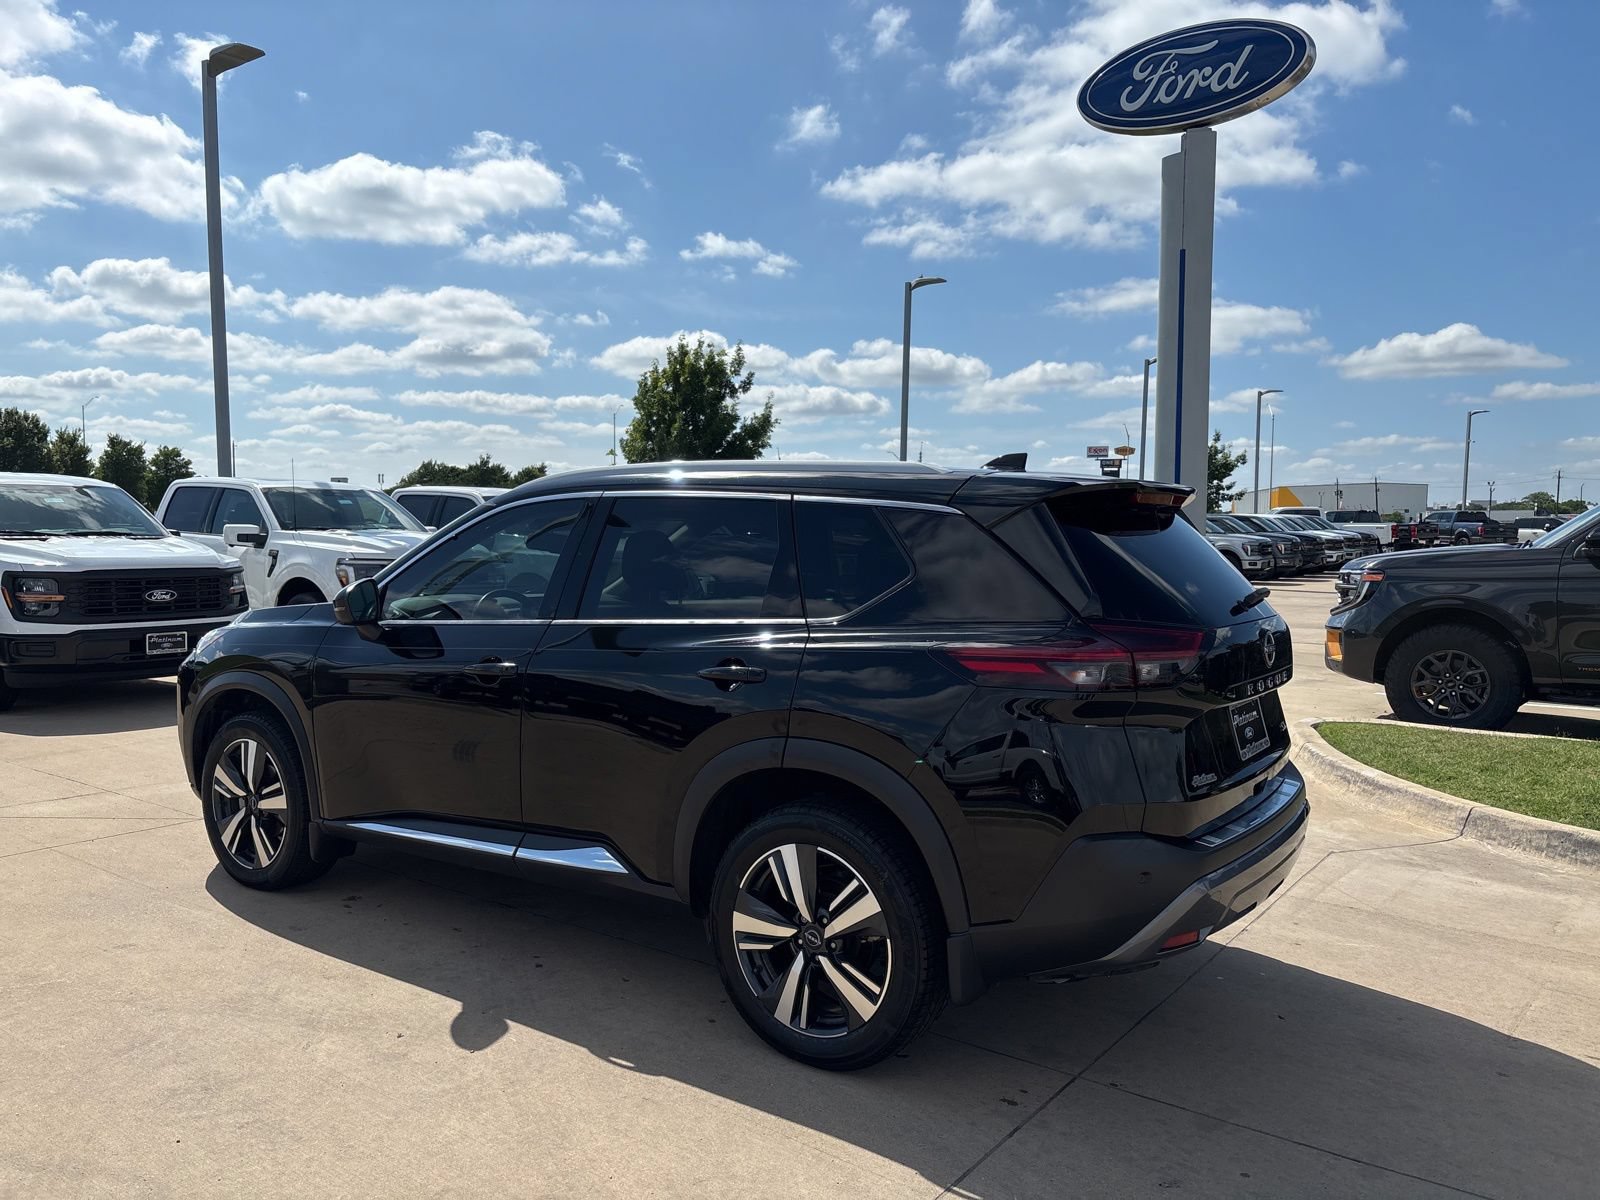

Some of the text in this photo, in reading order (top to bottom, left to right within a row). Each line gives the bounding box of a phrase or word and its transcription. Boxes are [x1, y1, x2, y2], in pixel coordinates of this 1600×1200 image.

[1119, 39, 1254, 112] Ford
[151, 591, 171, 600] Ford
[1247, 670, 1288, 696] ROGUE
